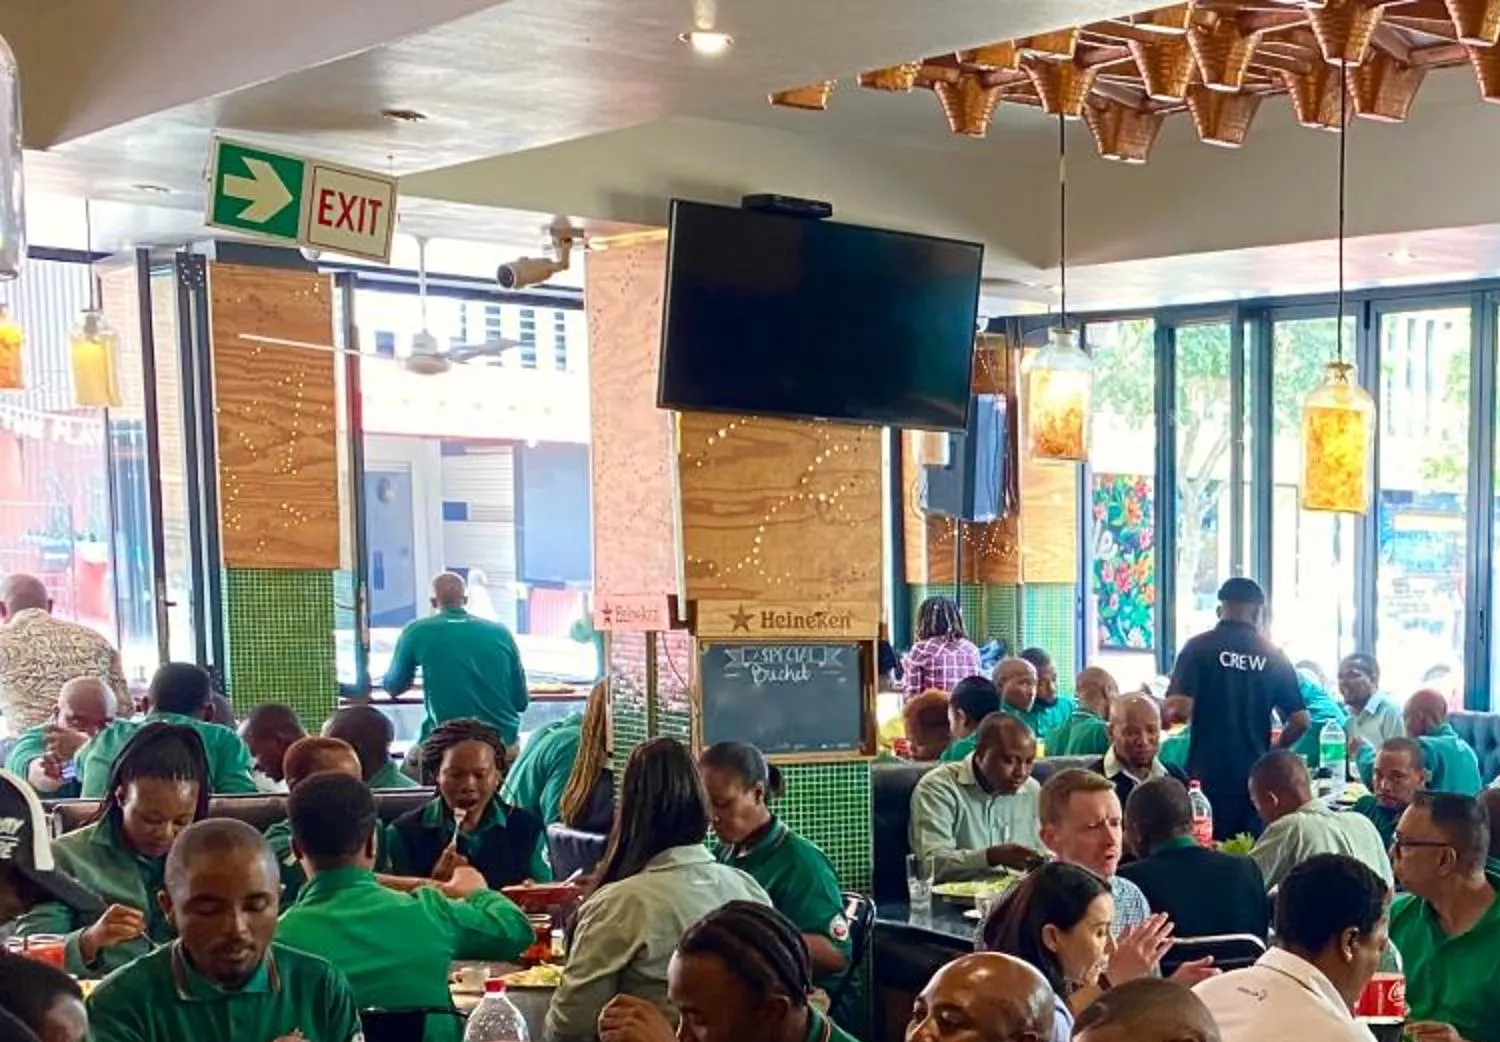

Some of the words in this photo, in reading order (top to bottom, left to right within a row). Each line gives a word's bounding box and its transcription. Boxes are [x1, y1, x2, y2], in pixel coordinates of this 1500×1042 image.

[318, 188, 383, 237] EXIT
[761, 610, 852, 630] Heineken
[1219, 651, 1268, 672] CREW
